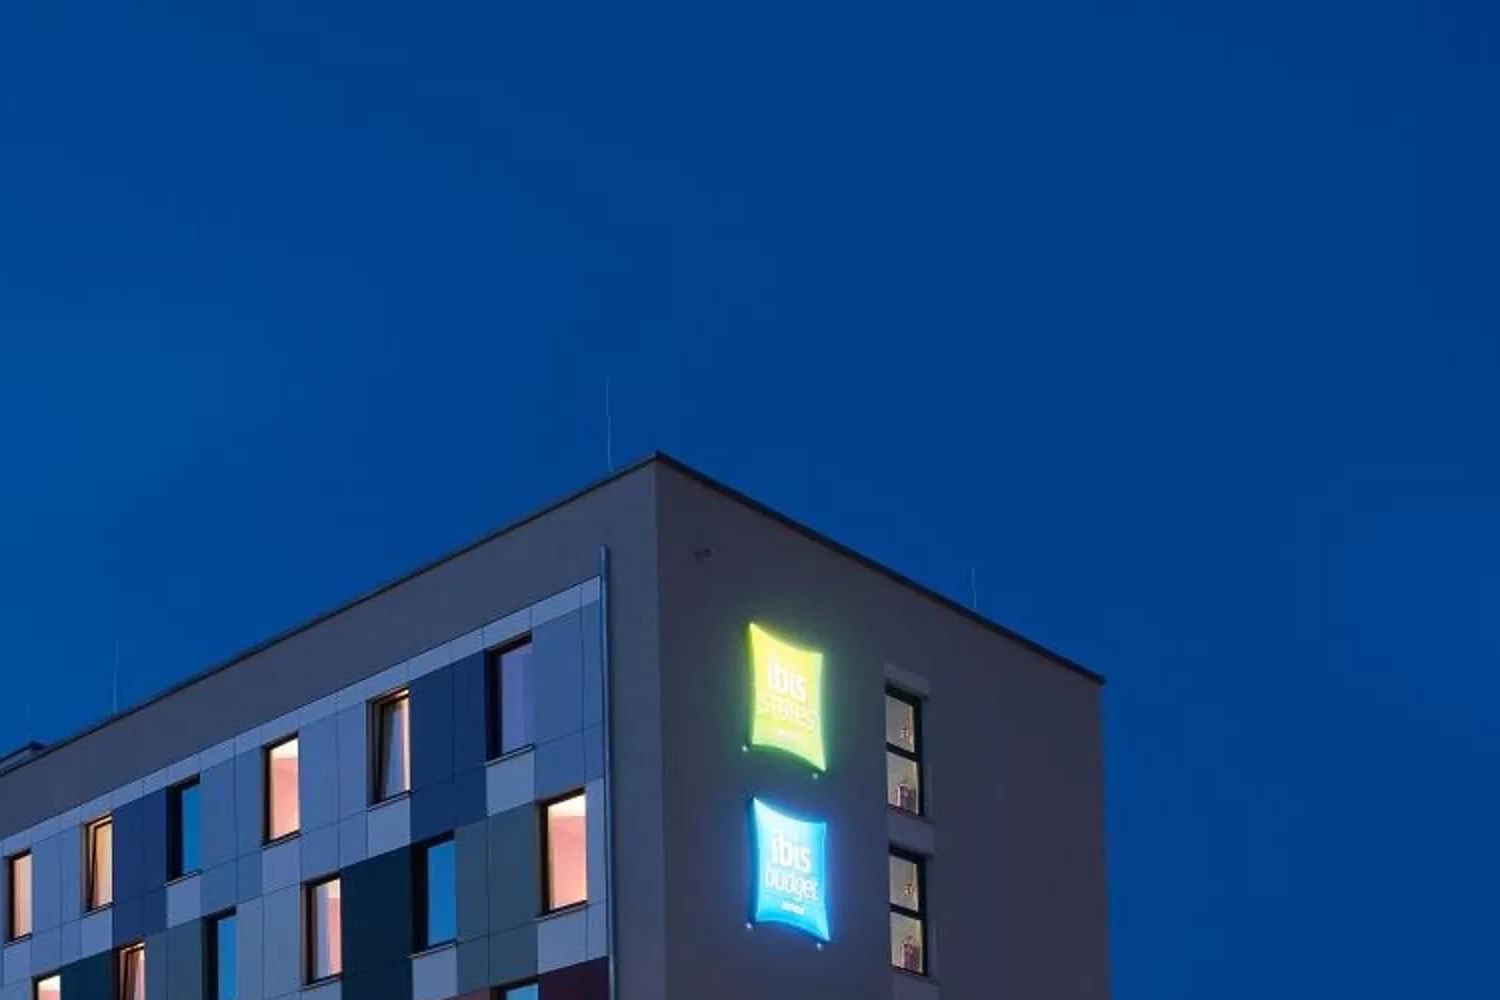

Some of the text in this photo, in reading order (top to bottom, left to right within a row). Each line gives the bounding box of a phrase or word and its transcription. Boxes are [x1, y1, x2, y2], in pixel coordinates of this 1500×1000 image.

[767, 657, 808, 700] ibis
[771, 828, 812, 874] ibis
[764, 860, 819, 902] budget
